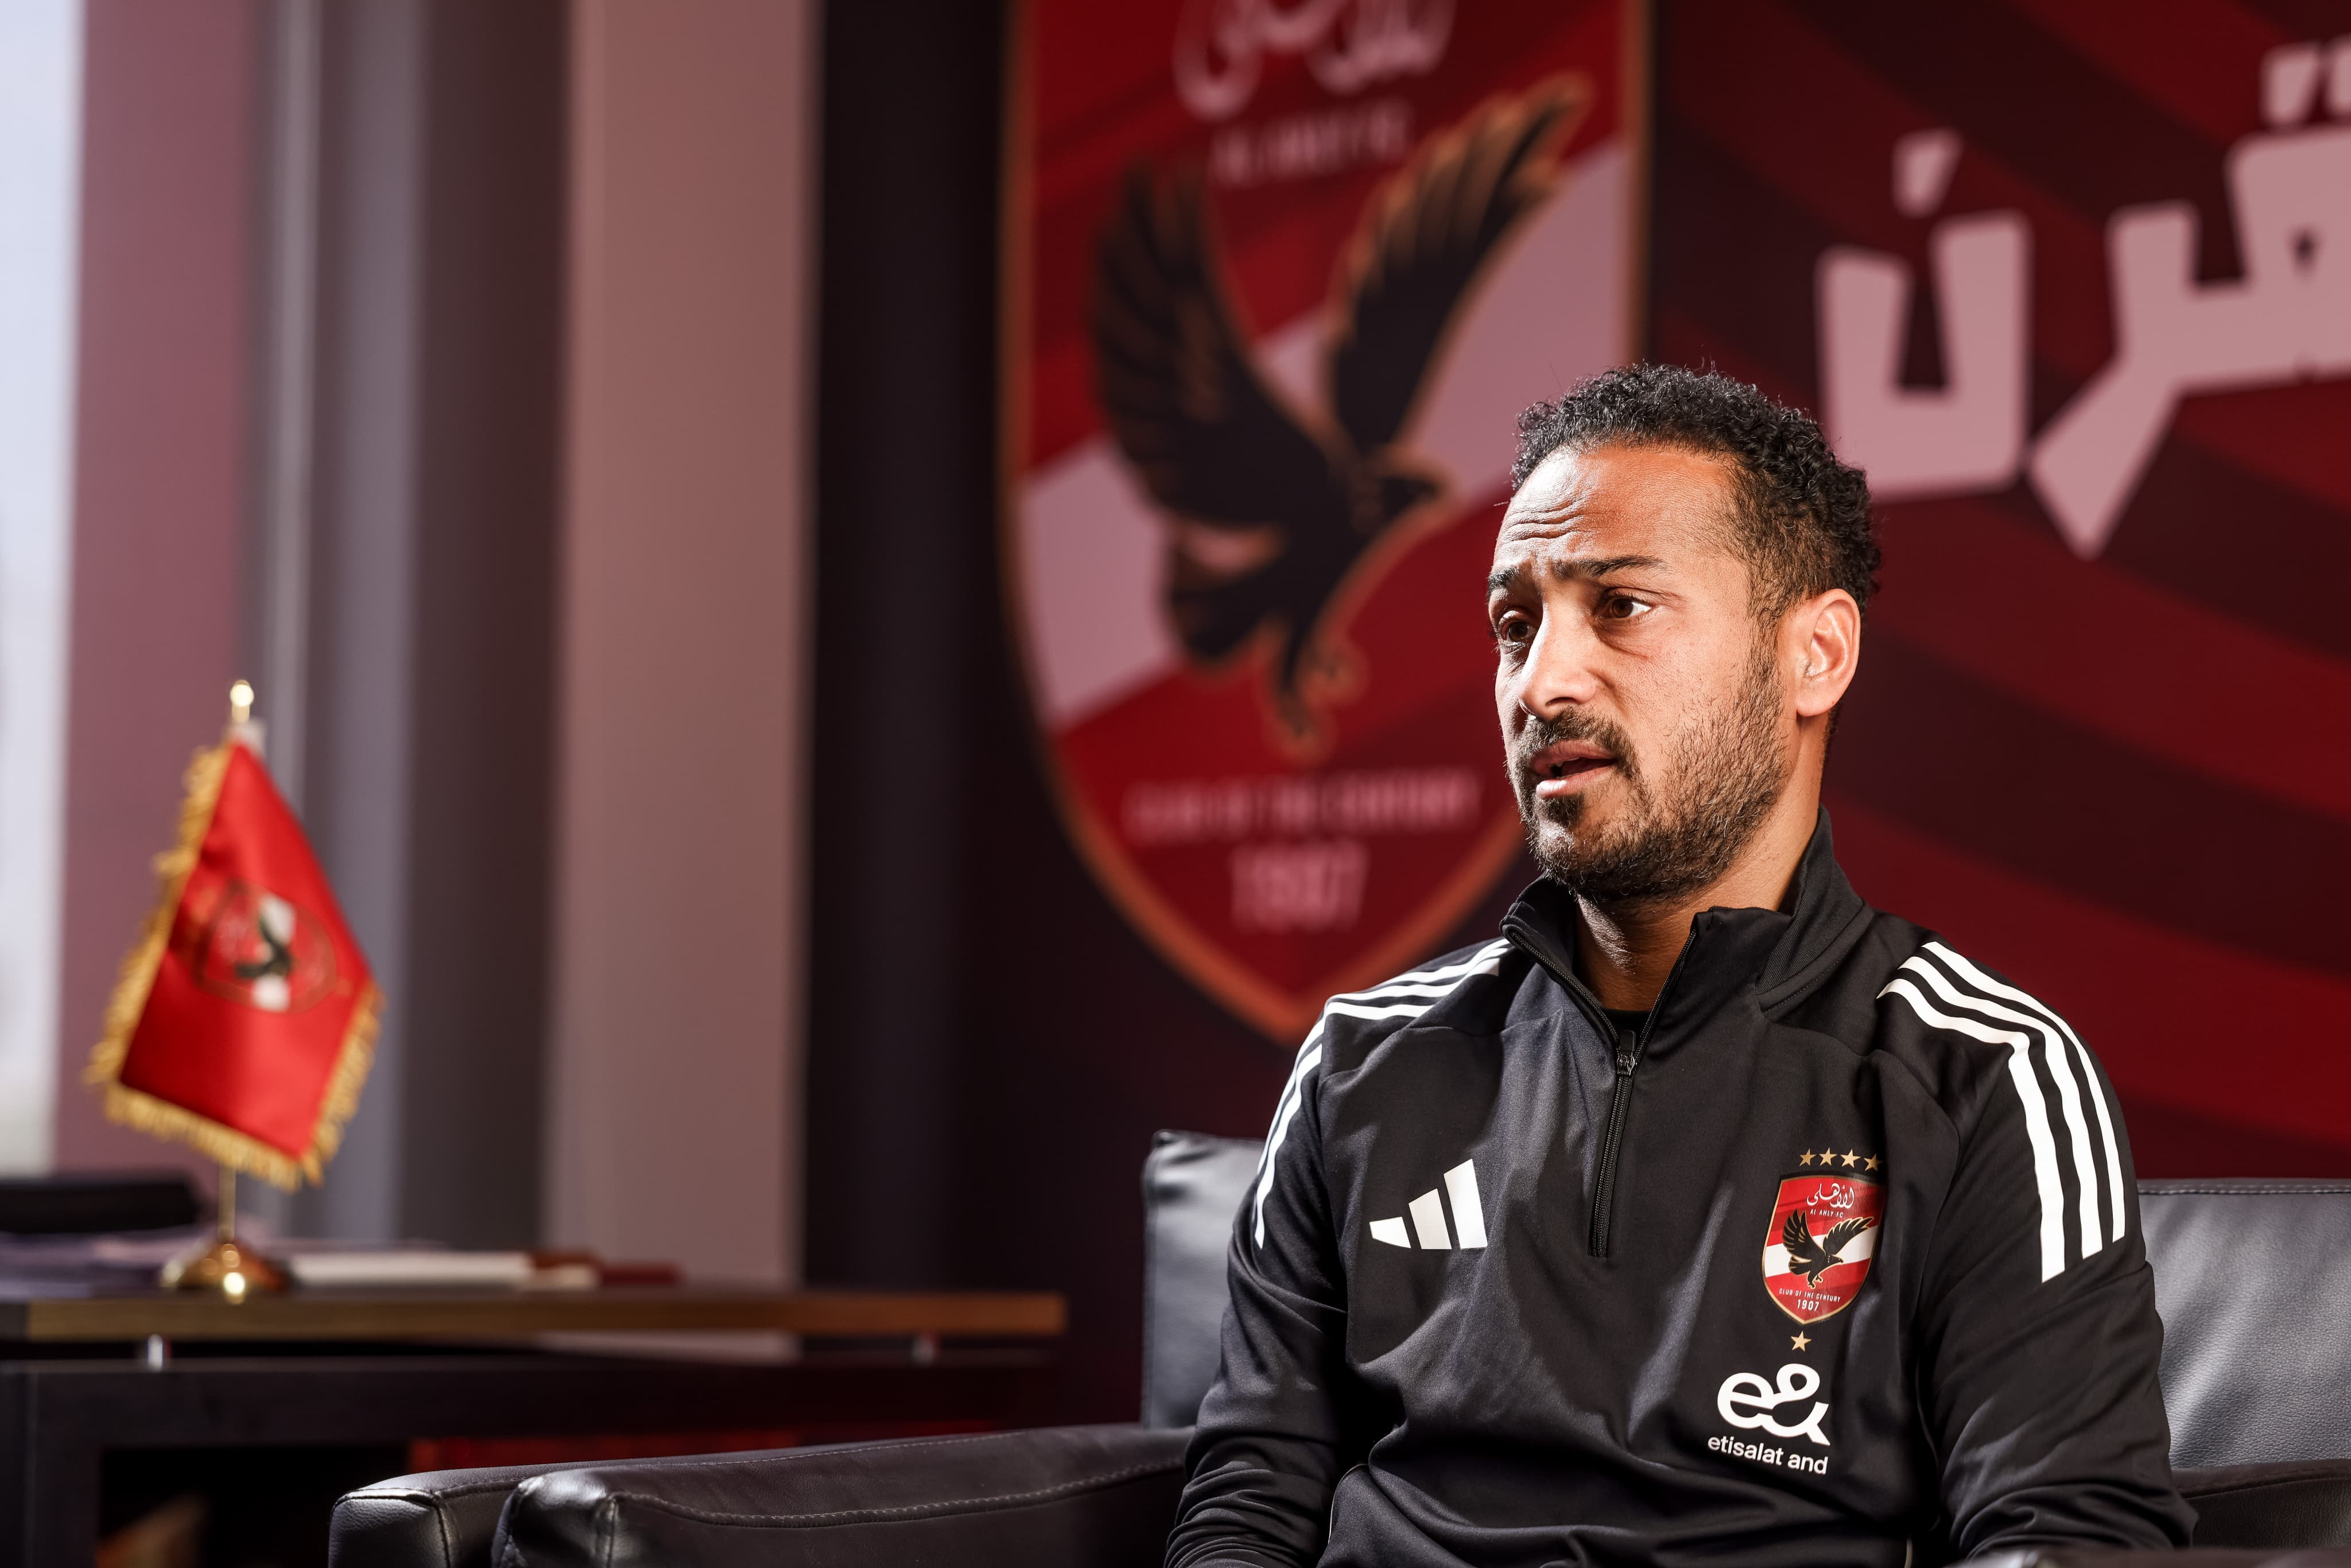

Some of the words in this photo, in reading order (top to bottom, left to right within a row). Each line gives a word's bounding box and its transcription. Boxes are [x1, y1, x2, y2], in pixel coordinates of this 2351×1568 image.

[1797, 1299, 1819, 1311] 1907
[1815, 1293, 1841, 1302] CENTURY
[1717, 1363, 1830, 1446] e&
[1708, 1435, 1784, 1466] etisalat
[1787, 1454, 1829, 1475] and
